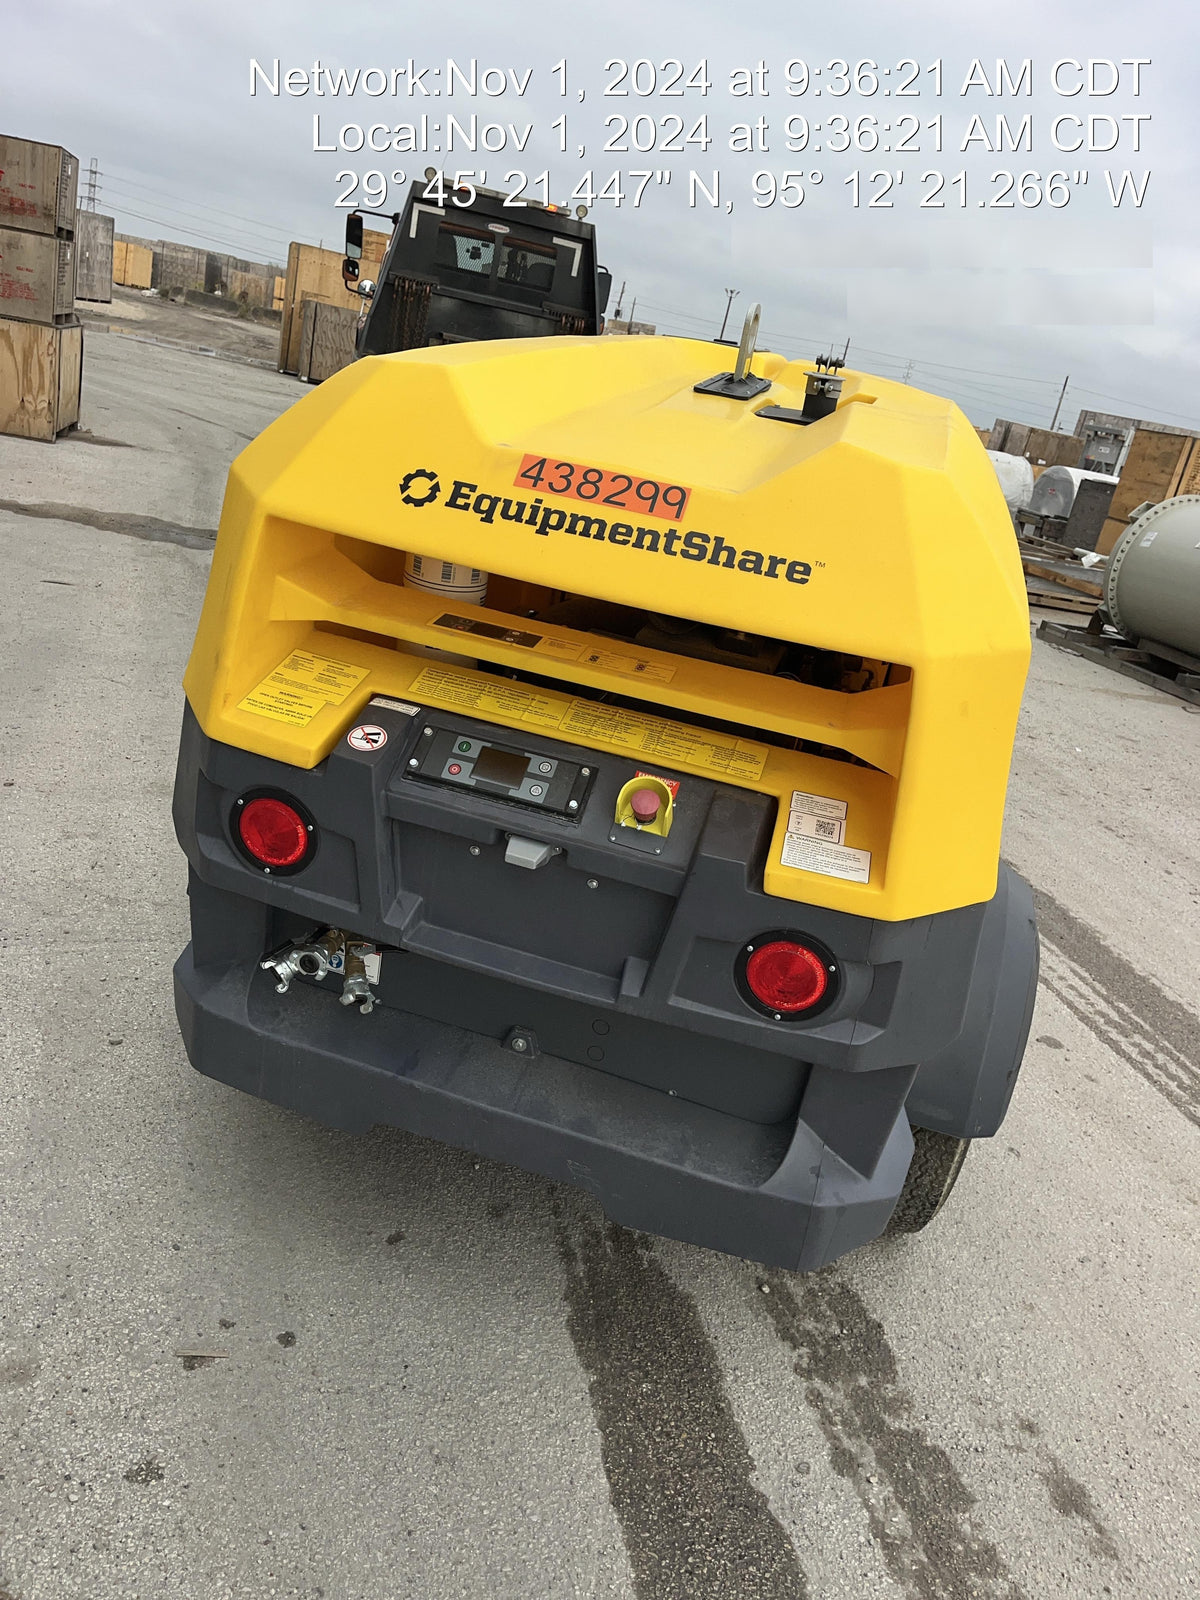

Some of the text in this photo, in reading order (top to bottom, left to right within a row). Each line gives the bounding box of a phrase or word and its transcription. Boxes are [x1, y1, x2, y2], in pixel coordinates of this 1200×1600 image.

[519, 457, 688, 520] 438299
[444, 480, 812, 585] EquipmentShare
[638, 771, 677, 787] EMNCY
